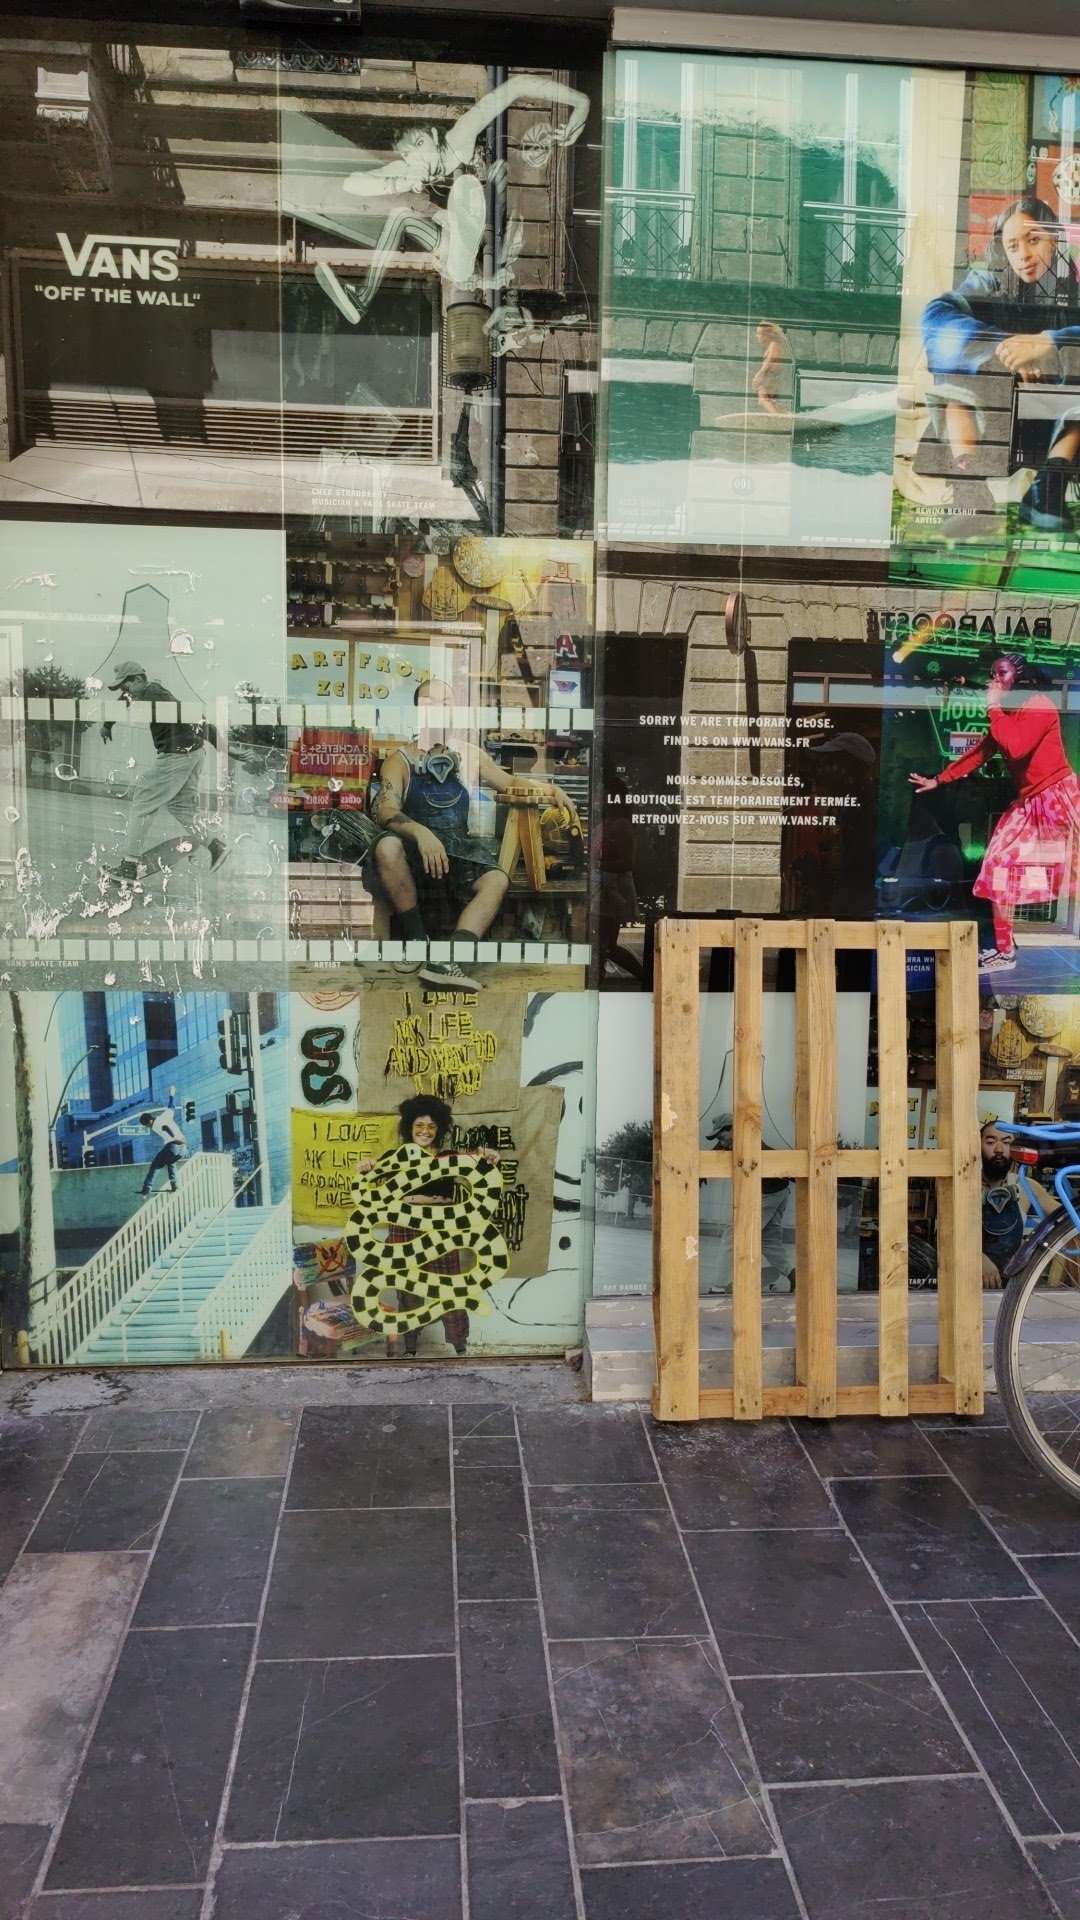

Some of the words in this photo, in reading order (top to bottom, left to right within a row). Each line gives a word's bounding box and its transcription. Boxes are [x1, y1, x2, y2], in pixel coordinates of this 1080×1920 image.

[56, 232, 181, 282] VANS
[91, 287, 131, 304] THE
[311, 498, 351, 507] MUSICIAN
[386, 500, 411, 509] SKATE
[414, 501, 436, 510] TEAM
[915, 517, 942, 525] ARTIST
[290, 650, 346, 670] ART
[316, 680, 390, 699] ZERO
[639, 715, 676, 726] SORRY
[680, 715, 697, 726] WE
[701, 716, 722, 727] ARE
[726, 716, 792, 728] TEMPORARY
[795, 718, 835, 729] CLOSE.
[663, 735, 690, 746] FIND
[694, 736, 709, 747] US
[713, 736, 728, 747] ON
[732, 736, 810, 748] WWW.VANS.FR
[666, 775, 697, 786] NOUS
[700, 775, 747, 786] SOMMES
[752, 773, 804, 788] DÉSOLÉS,
[607, 794, 621, 804] LA
[625, 794, 682, 806] BOUTIQUE
[686, 795, 706, 806] EST
[710, 795, 810, 807] TEMPORAIREMENT
[814, 794, 861, 807] FERMÉE.
[631, 814, 729, 826] RETROUVEZ-NOUS
[733, 815, 755, 826] SUR
[759, 815, 837, 826] WWW.VANS.FR
[314, 961, 341, 969] ARTIST
[427, 1009, 473, 1042] LIFE
[327, 1121, 379, 1144] LOVE
